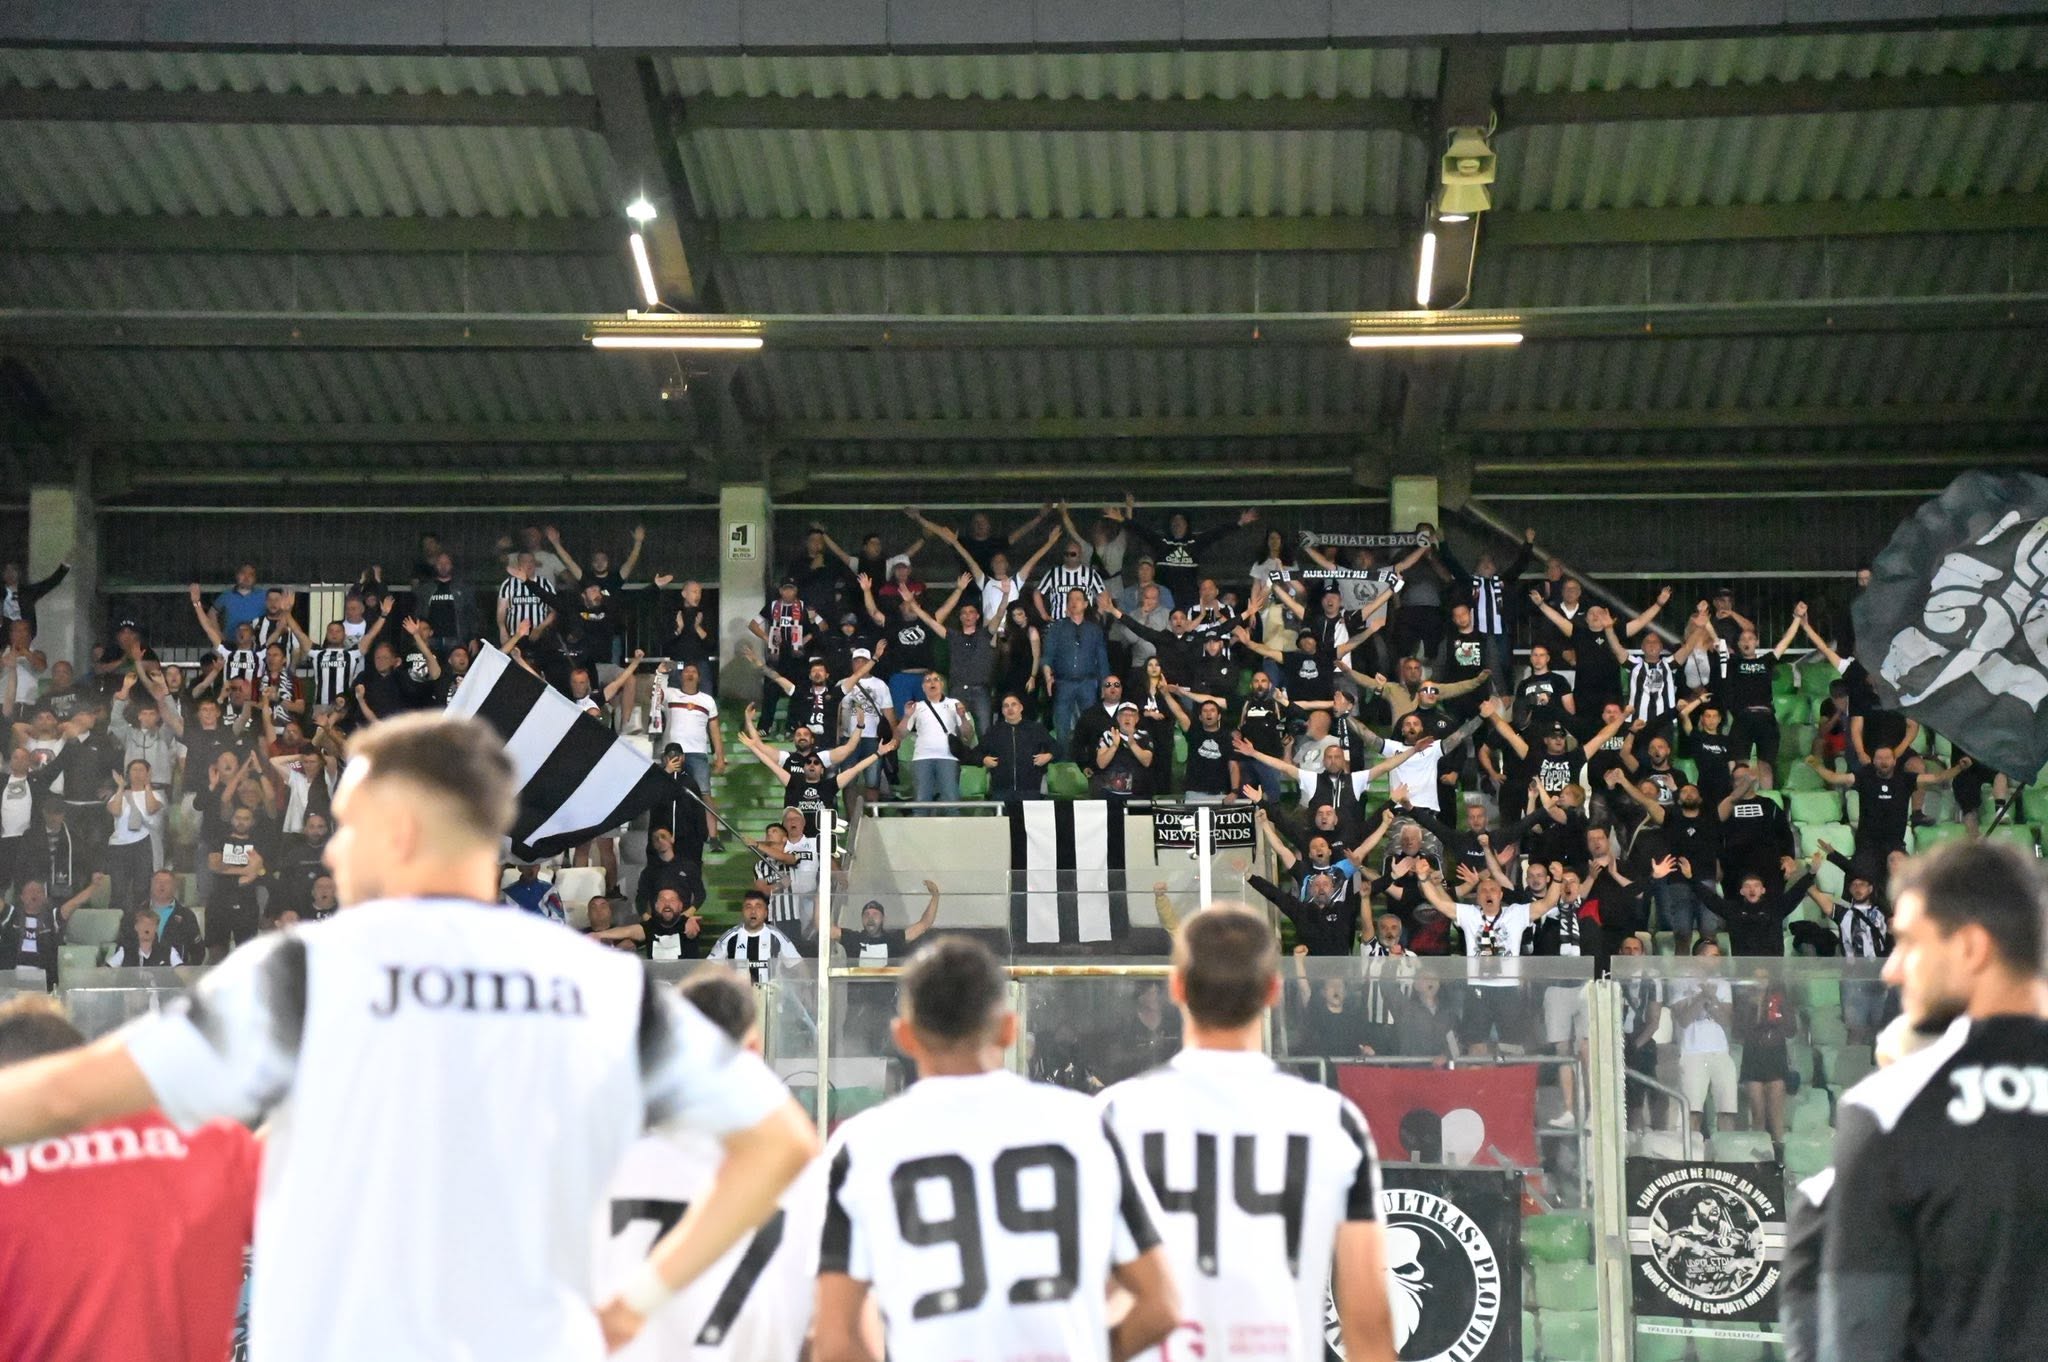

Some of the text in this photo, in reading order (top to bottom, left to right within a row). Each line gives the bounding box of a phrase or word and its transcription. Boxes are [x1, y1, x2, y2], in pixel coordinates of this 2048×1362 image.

[1320, 533, 1375, 546] ВИНАГИ
[1378, 535, 1386, 546] С
[1155, 812, 1253, 825] LOKTION
[1158, 829, 1201, 841] NEVE
[1141, 1131, 1310, 1277] 44
[1637, 1168, 1776, 1217] ЕДИН ЧОВЕК НЕ МОЖЕ ДА УМРЕ
[890, 1143, 1078, 1320] 99
[1382, 1192, 1479, 1244] ULTRAS
[1660, 1282, 1670, 1292] С
[1667, 1287, 1693, 1309] ОБИЧ
[1694, 1300, 1702, 1311] В
[1702, 1298, 1748, 1315] СЪРЦАТА
[1755, 1266, 1780, 1298] ЖИВЕЕ
